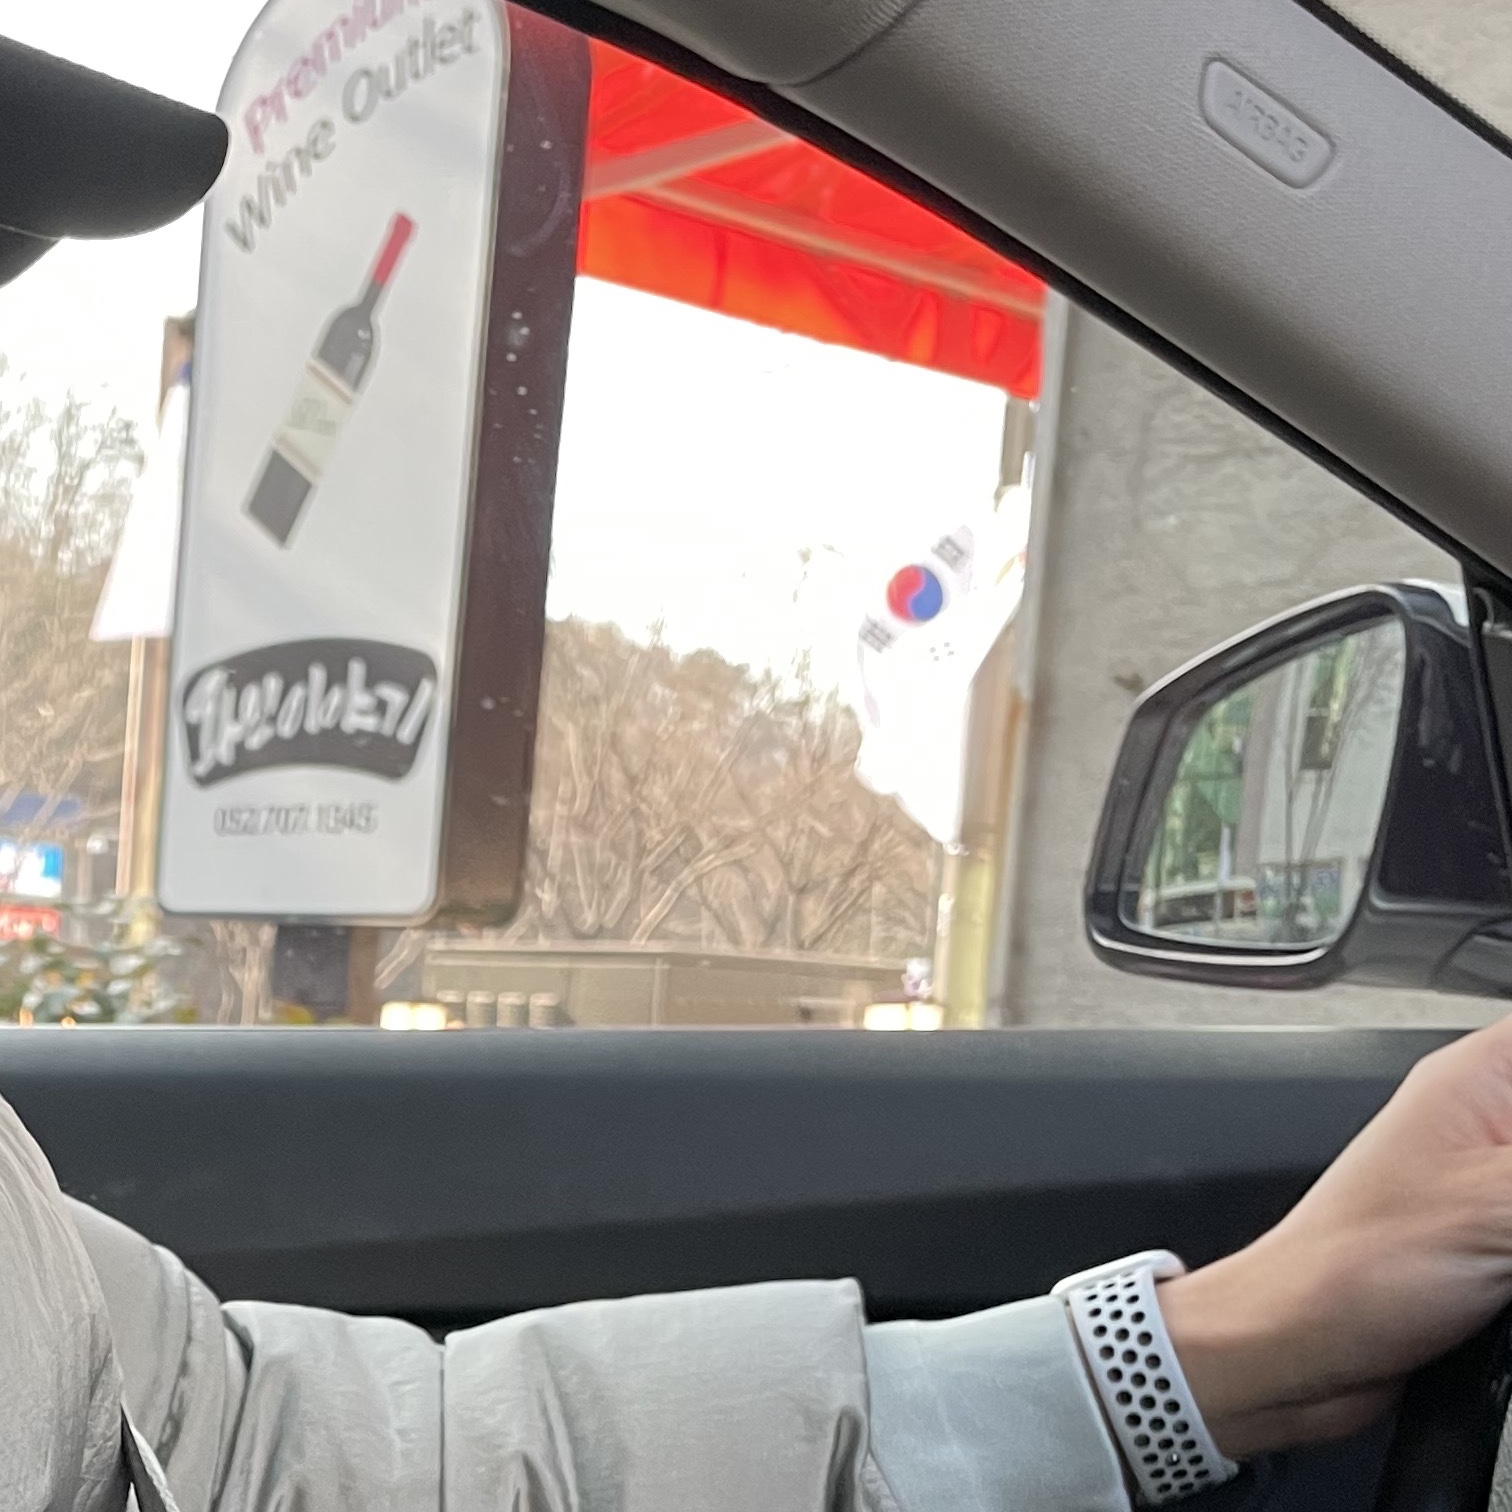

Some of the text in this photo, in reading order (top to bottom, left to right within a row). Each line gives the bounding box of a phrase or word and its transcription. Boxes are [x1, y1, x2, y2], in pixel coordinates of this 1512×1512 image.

[223, 7, 480, 254] Wine Outlet
[184, 656, 437, 779] 와인이야기
